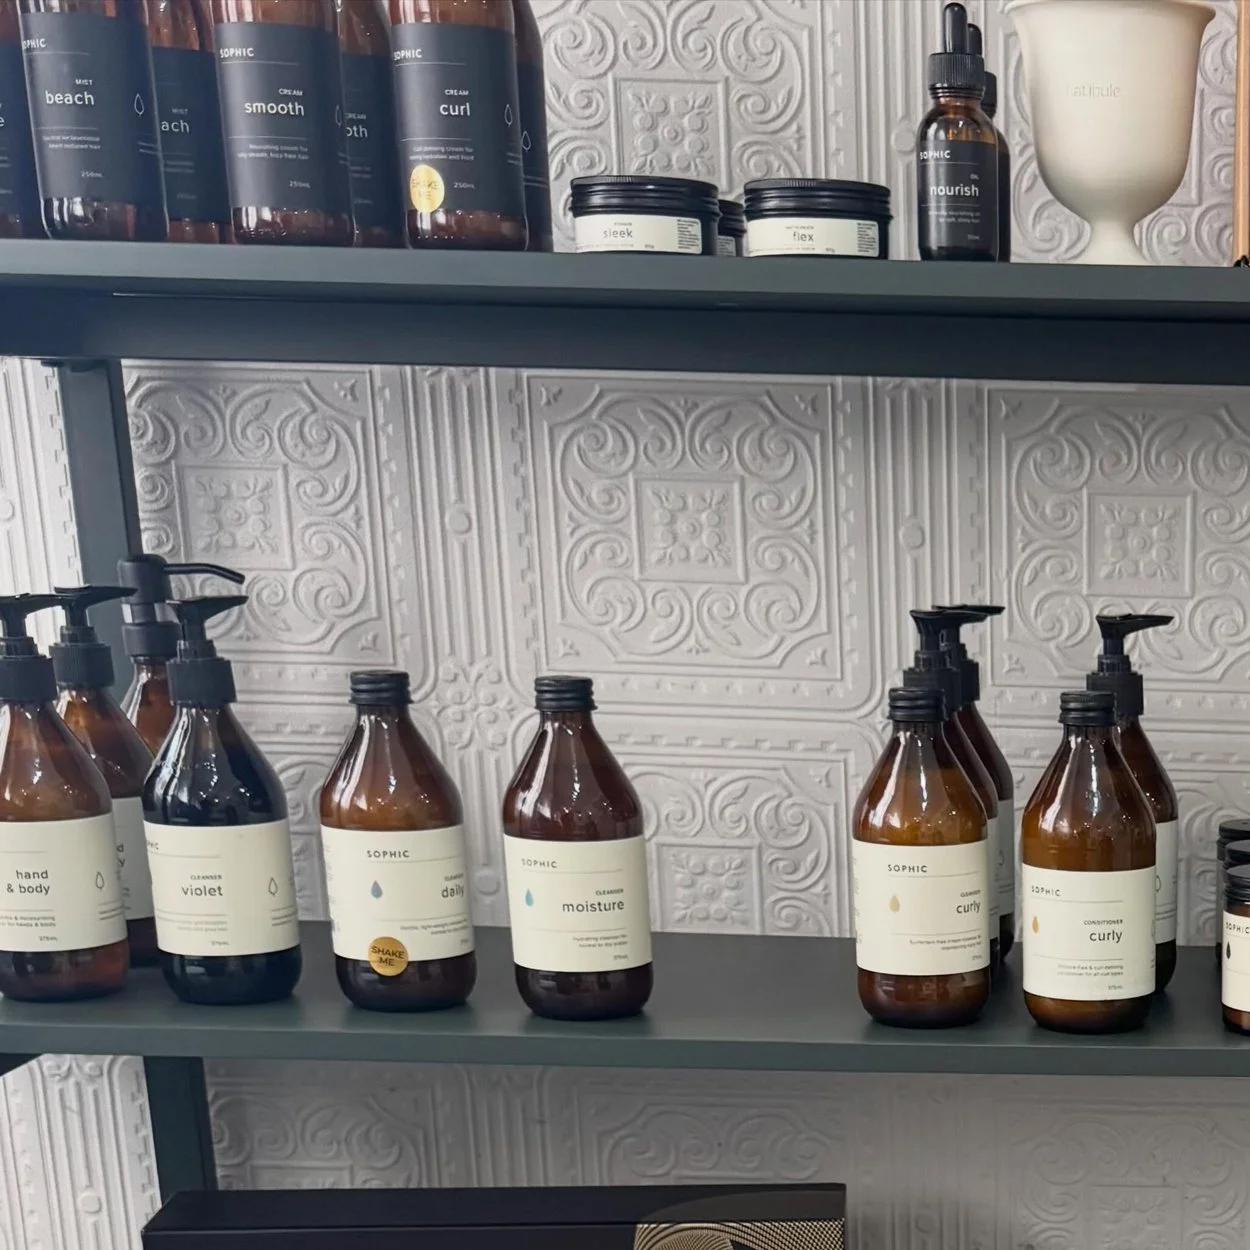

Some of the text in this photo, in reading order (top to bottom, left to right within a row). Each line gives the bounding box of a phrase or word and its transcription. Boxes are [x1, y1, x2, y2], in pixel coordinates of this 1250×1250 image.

[22, 38, 47, 50] OPHIC
[220, 48, 255, 58] SOPHIC
[45, 90, 95, 106] beach
[278, 88, 303, 96] CREAM
[244, 101, 305, 117] smooth
[439, 102, 471, 117] curl
[161, 120, 190, 133] ach
[920, 150, 951, 160] SOPHIC
[929, 184, 979, 197] nourish
[603, 227, 633, 238] sleek
[793, 231, 814, 242] flex
[366, 850, 410, 858] SOPHIC
[521, 858, 557, 868] SOPHIC
[887, 864, 928, 873] SOPHIC
[16, 869, 49, 880] hand
[6, 883, 50, 896] & body
[181, 884, 224, 897] violet
[441, 884, 465, 898] daily
[1031, 885, 1060, 897] SOPHIC
[562, 900, 625, 912] moisture
[956, 900, 981, 914] curly
[1225, 922, 1250, 934] SOPHIC
[1089, 929, 1123, 944] curly
[371, 945, 405, 959] SHAKE
[378, 957, 395, 967] ME
